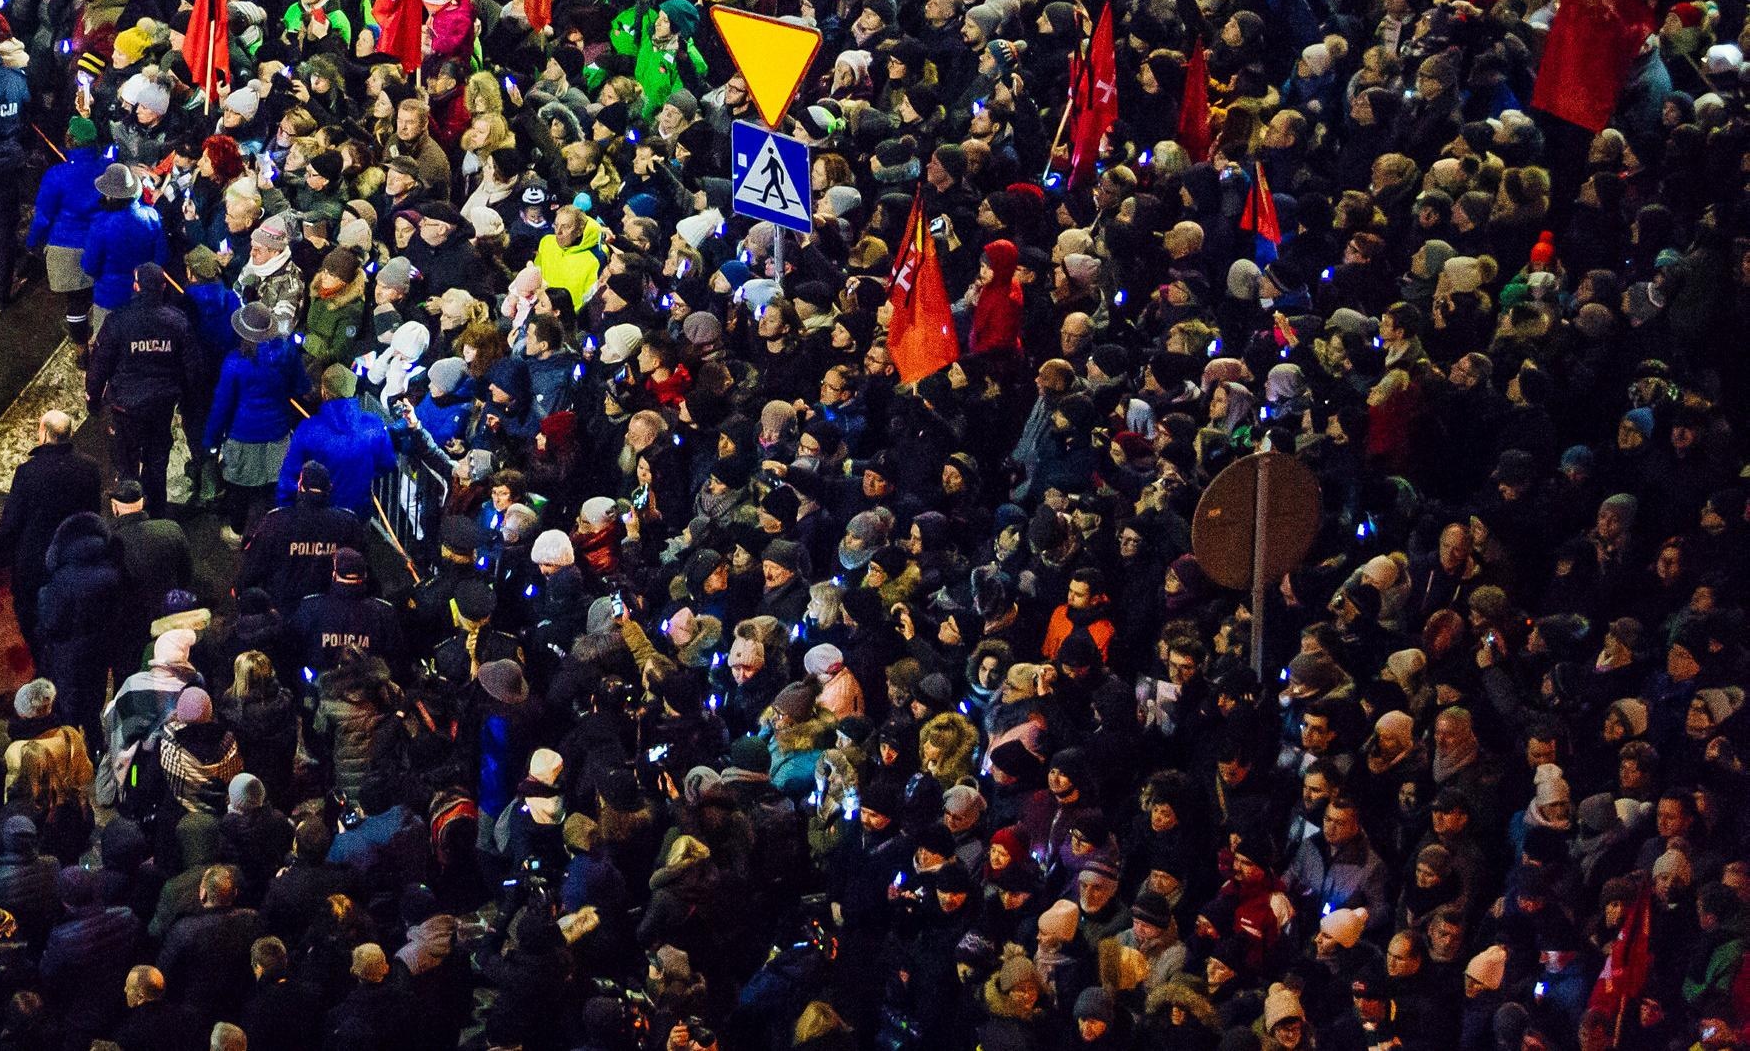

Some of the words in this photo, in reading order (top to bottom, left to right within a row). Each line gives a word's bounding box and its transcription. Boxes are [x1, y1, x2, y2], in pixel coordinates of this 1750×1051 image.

[130, 339, 172, 354] POLICJA
[290, 541, 337, 556] POLICJA
[322, 633, 370, 648] POLICJA
